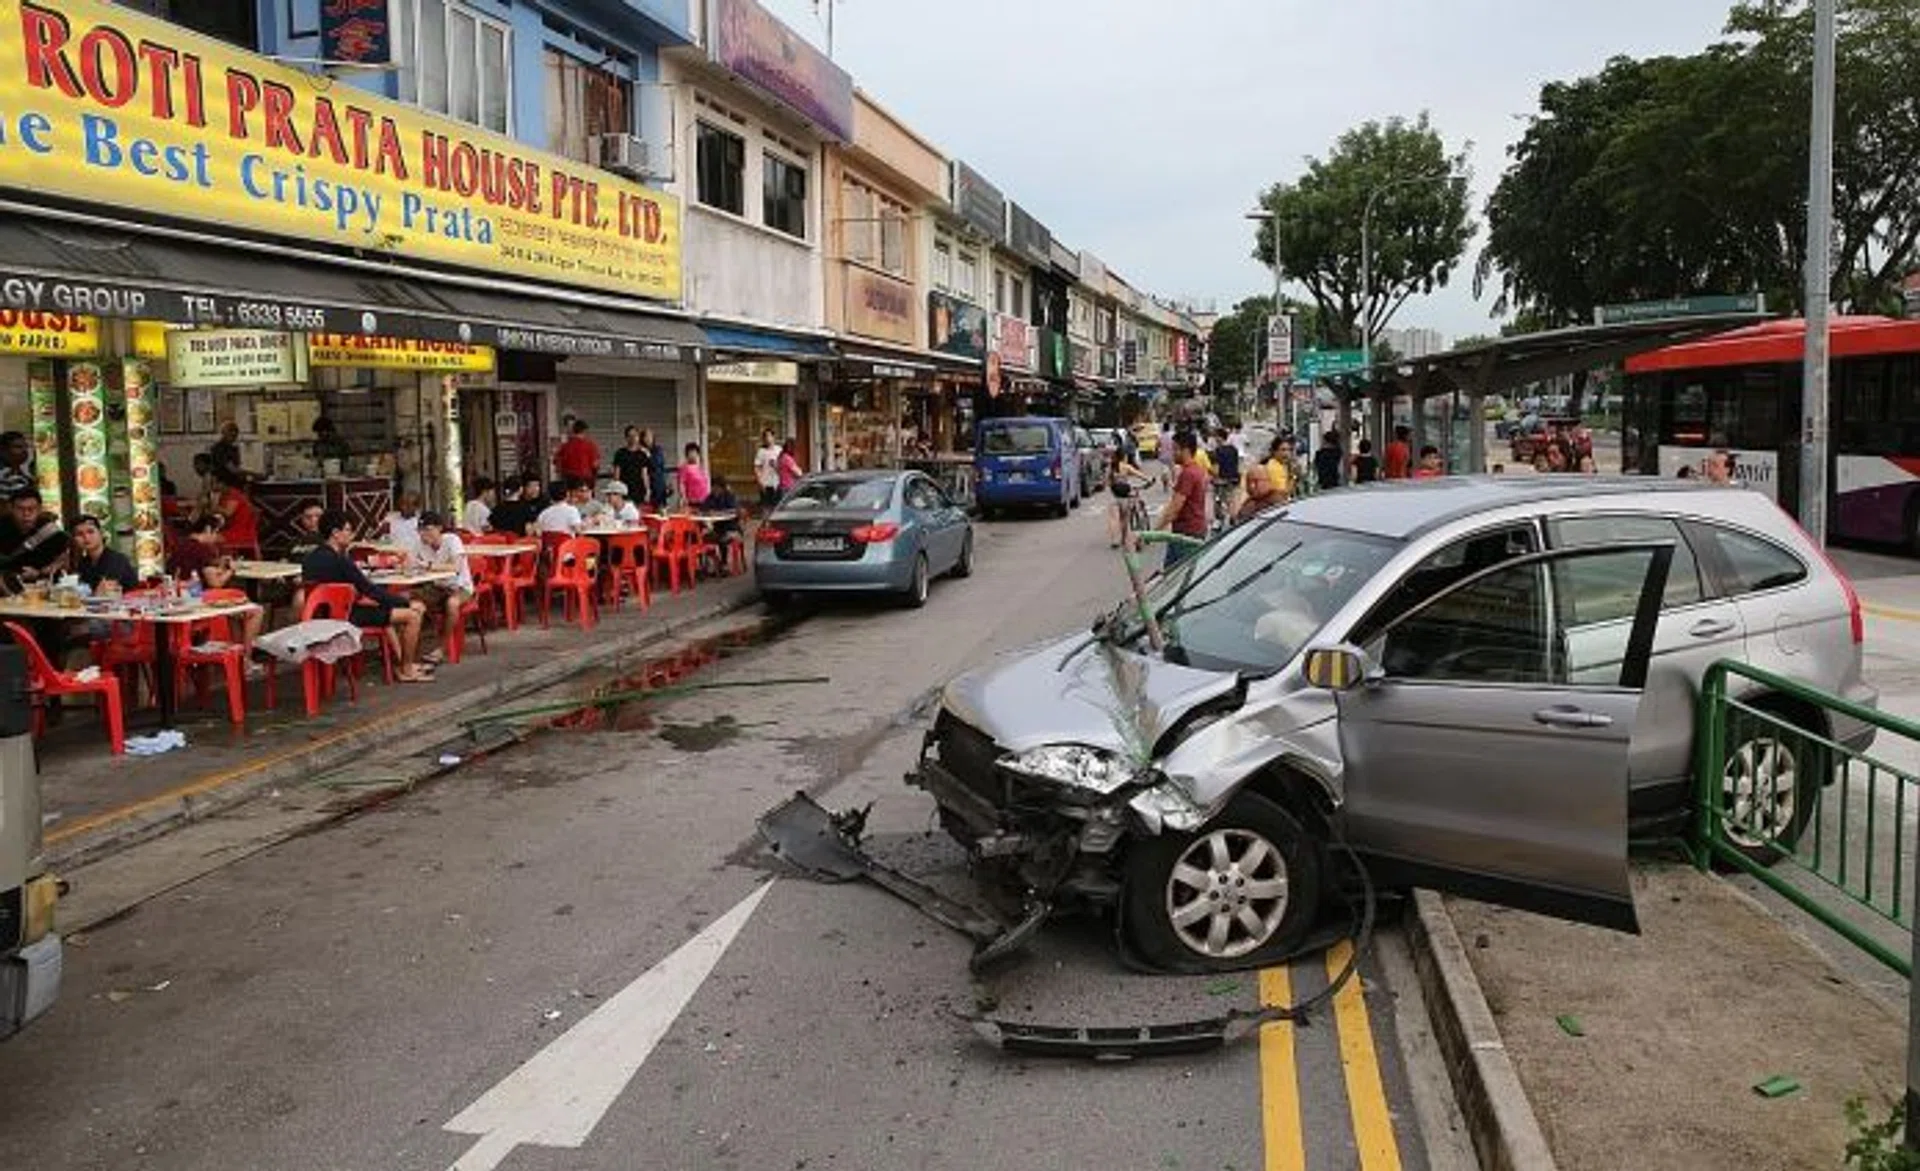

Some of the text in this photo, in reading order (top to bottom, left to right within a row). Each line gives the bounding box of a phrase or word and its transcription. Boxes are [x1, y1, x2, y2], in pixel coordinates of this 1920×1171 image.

[20, 1, 208, 128] ROTI
[224, 67, 409, 181] PRATA
[422, 129, 543, 214] HOUSE
[0, 112, 53, 154] e
[82, 113, 212, 188] Best
[240, 154, 382, 233] Crispy
[401, 191, 494, 245] Prata
[4, 277, 45, 308] GY
[52, 284, 146, 314] GROUP
[181, 295, 223, 322] TEL
